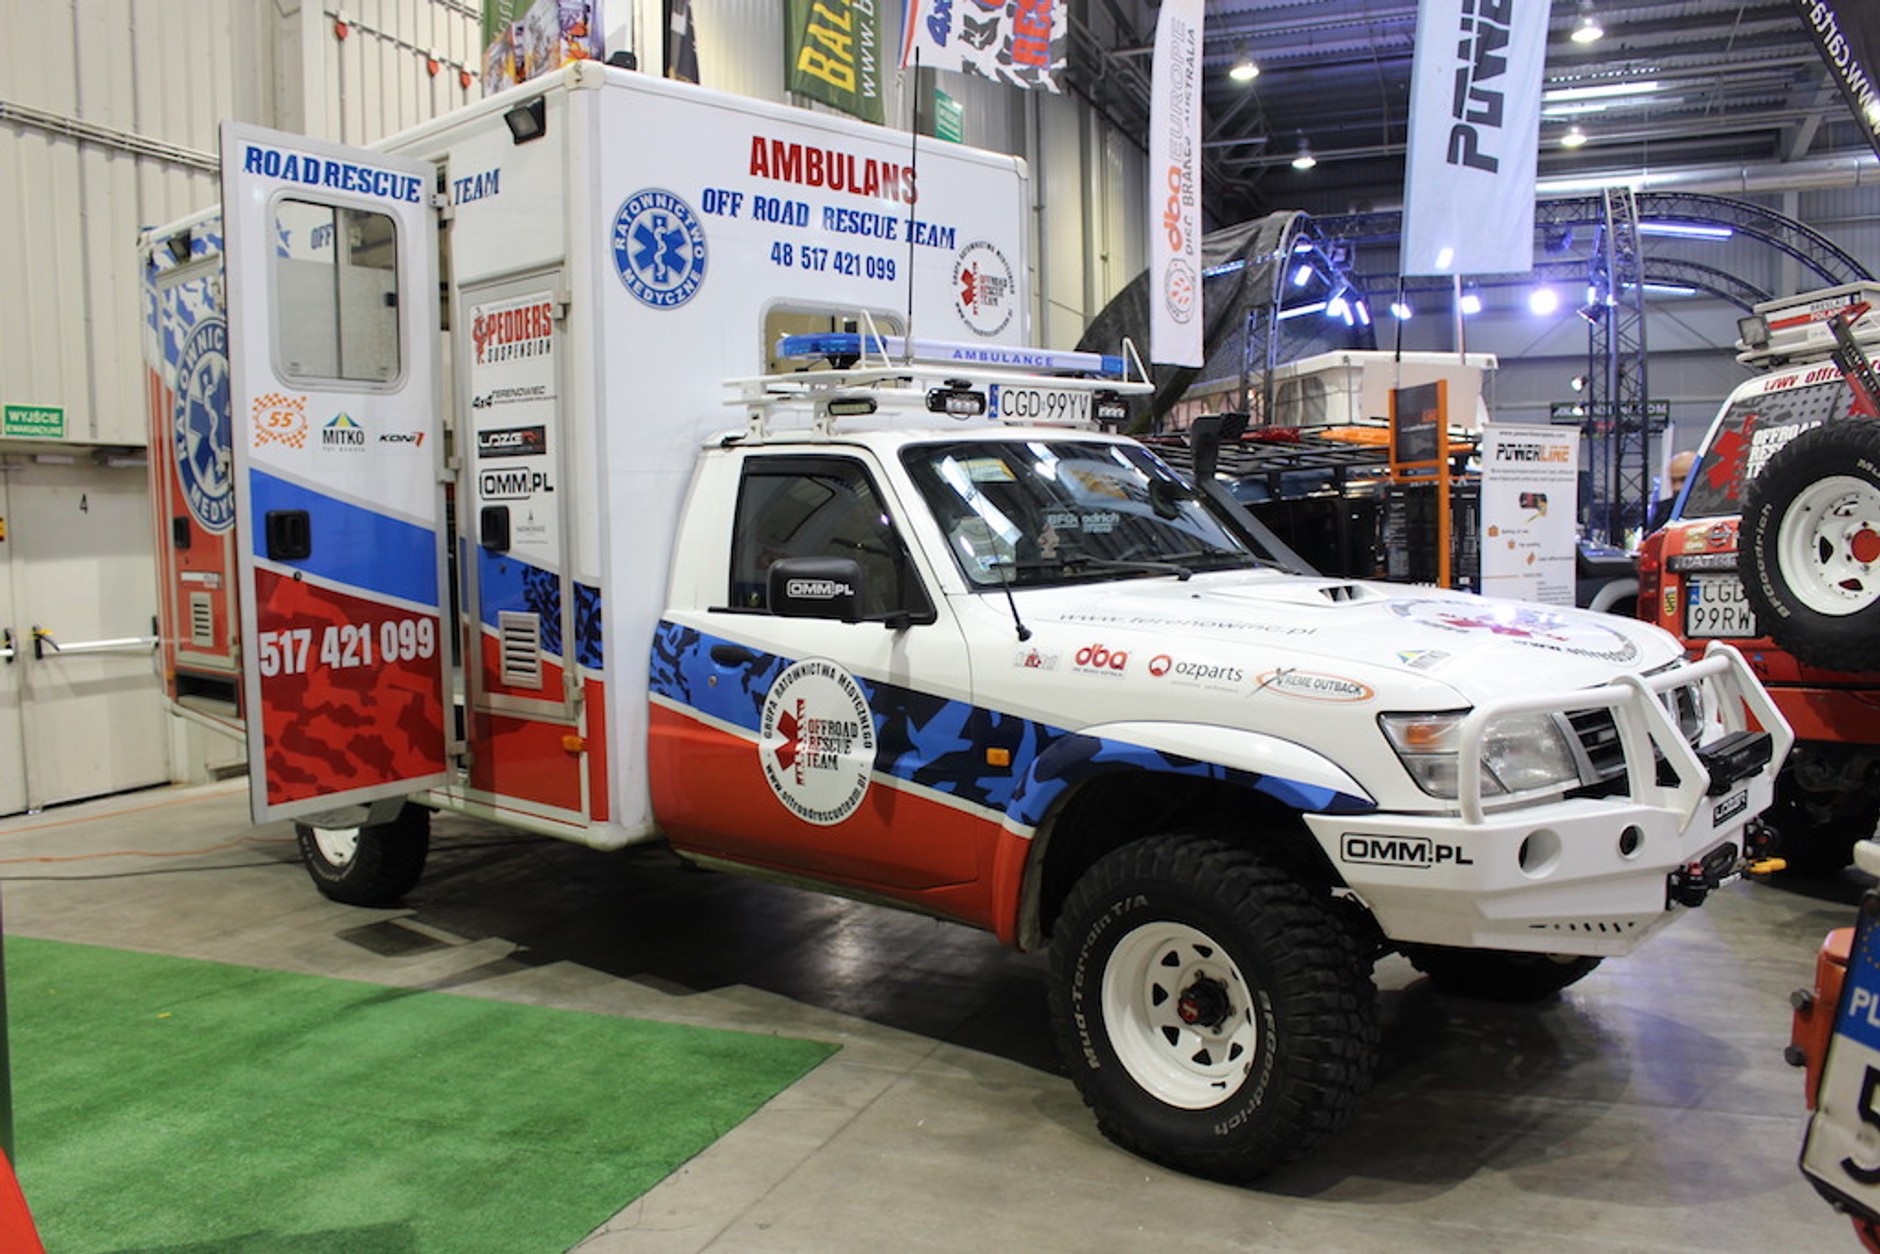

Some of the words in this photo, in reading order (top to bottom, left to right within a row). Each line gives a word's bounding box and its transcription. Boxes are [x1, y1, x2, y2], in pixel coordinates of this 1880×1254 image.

[798, 0, 856, 93] BAL
[749, 135, 918, 205] AMBULANS
[453, 168, 500, 206] TEAM
[615, 193, 705, 259] RATOWNICTWO
[701, 187, 744, 218] OFF
[752, 195, 810, 228] ROAD
[822, 206, 898, 241] RESCUE
[903, 219, 956, 250] TEAM
[311, 223, 333, 250] OFF
[771, 241, 793, 267] 48
[801, 246, 828, 272] 517
[833, 251, 861, 276] 421
[866, 256, 896, 282] 099
[622, 269, 702, 304] MEDYCZNE
[486, 303, 552, 346] PEDDERS
[488, 339, 551, 363] SUSPENSION
[953, 349, 1054, 367] AMBULANCE
[1002, 389, 1041, 418] CGD
[8, 410, 60, 424] WYJŚCIE
[267, 411, 295, 428] 55
[323, 429, 365, 445] MITKO
[485, 472, 554, 494] OMM.PL
[79, 493, 88, 514] 4
[791, 583, 855, 596] OMM.PL
[259, 628, 312, 677] 517
[320, 623, 372, 669] 421
[380, 617, 435, 663] 099
[1075, 643, 1128, 671] dba
[1175, 661, 1243, 683] ozparts
[1313, 678, 1362, 695] OUTBACK
[764, 701, 778, 739] GRUPA
[775, 662, 835, 699] RATOWNICTWA
[838, 673, 873, 749] MEDYCZNEGO
[807, 718, 859, 739] OFFROAD
[807, 737, 853, 755] RESCUE
[806, 752, 839, 771] TEAM
[1347, 839, 1474, 865] OMM.PL
[1111, 894, 1148, 918] T/A
[1213, 989, 1278, 1136] BFGoodrich
